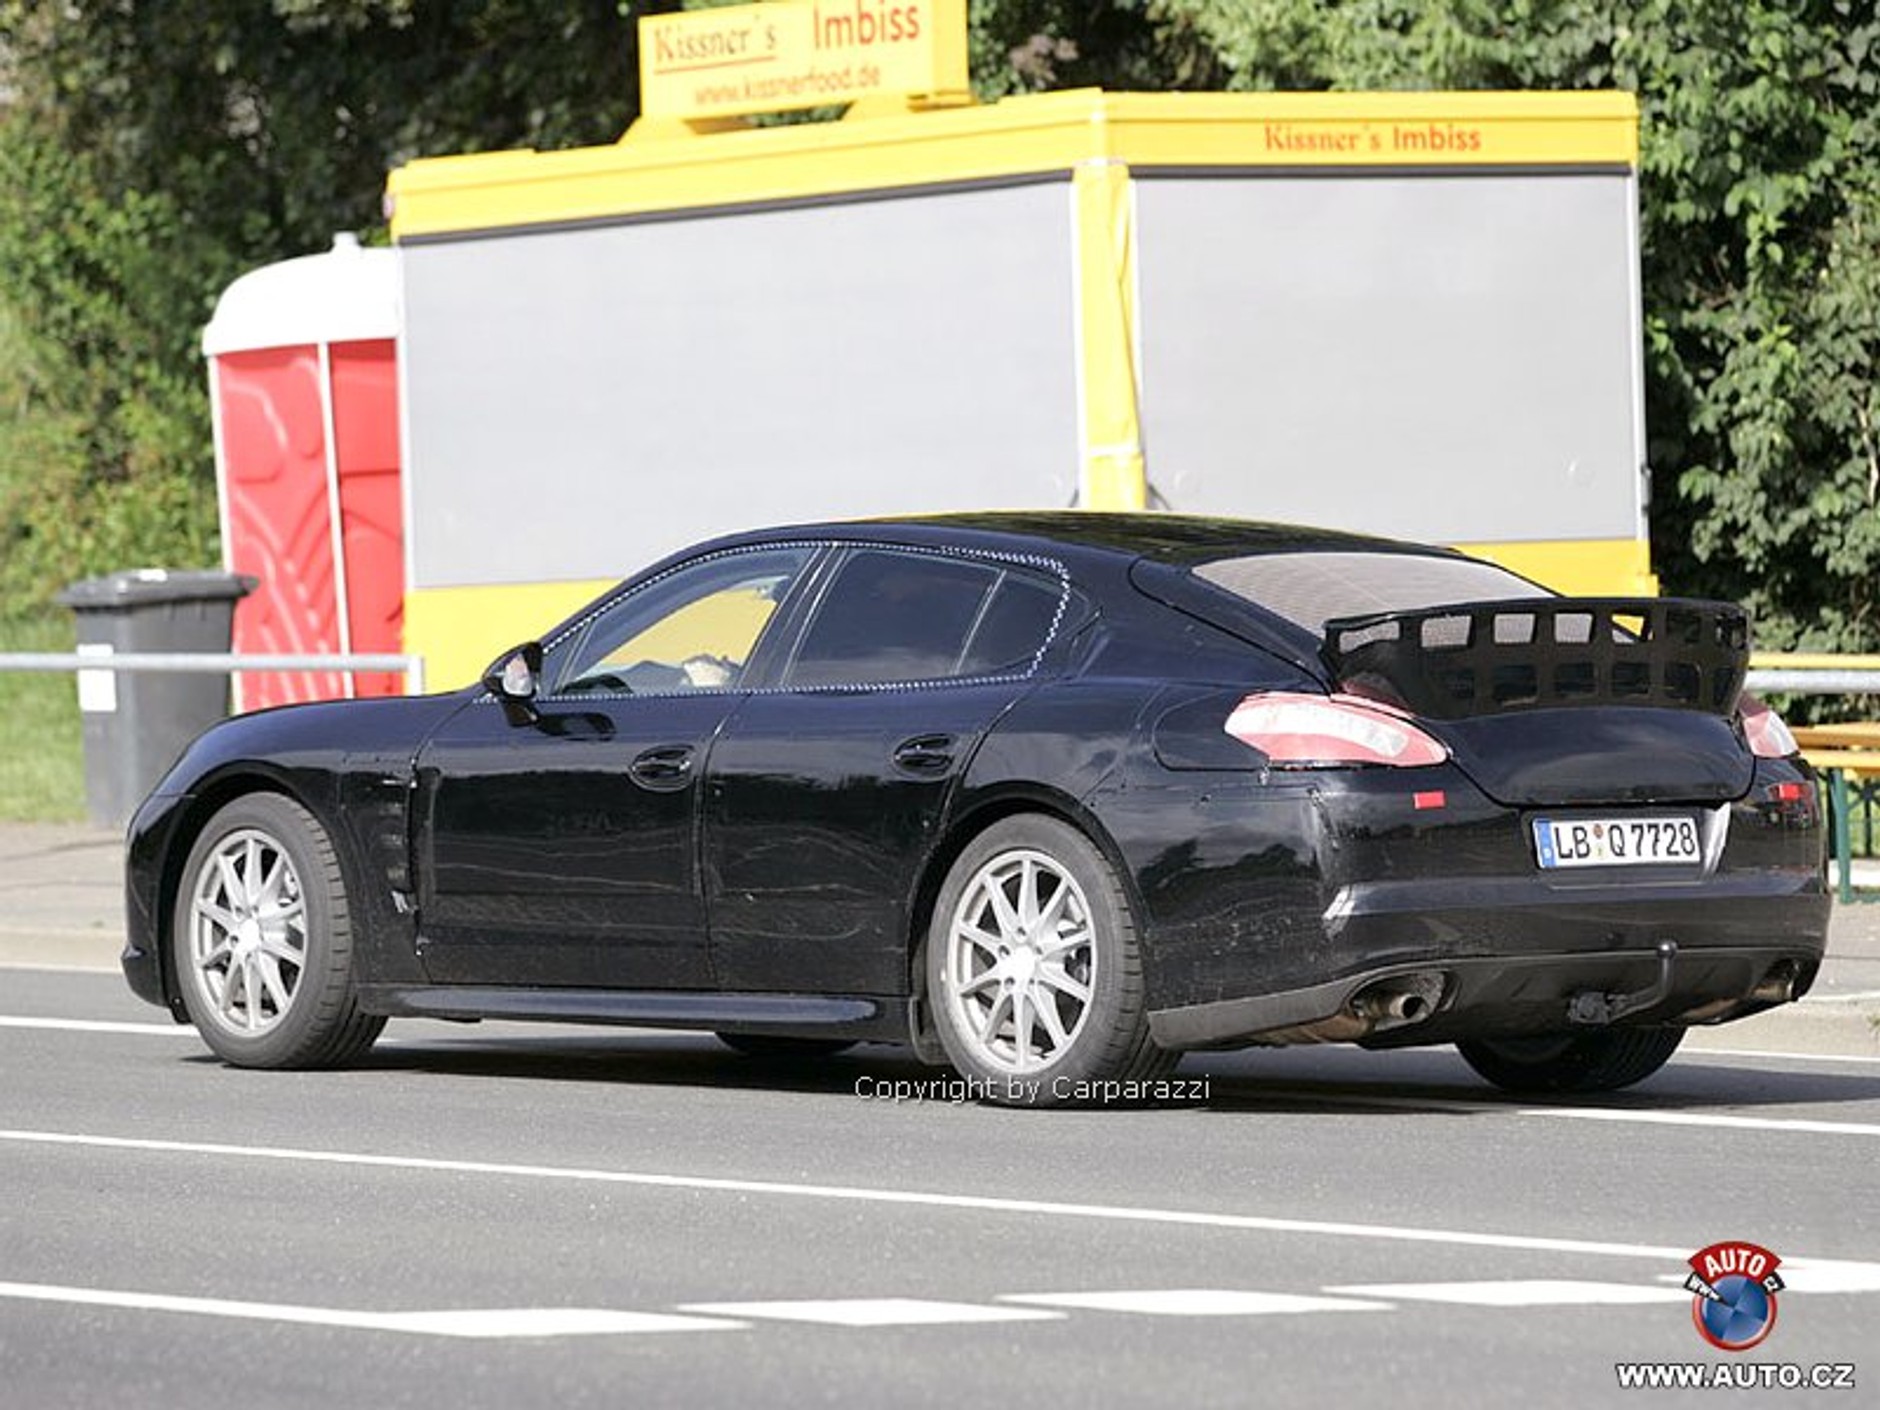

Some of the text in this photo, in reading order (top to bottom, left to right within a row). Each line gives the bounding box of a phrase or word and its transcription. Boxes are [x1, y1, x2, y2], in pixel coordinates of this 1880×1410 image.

[812, 0, 920, 50] Imbiss
[1393, 122, 1481, 151] Imbiss
[1554, 826, 1590, 859] LB
